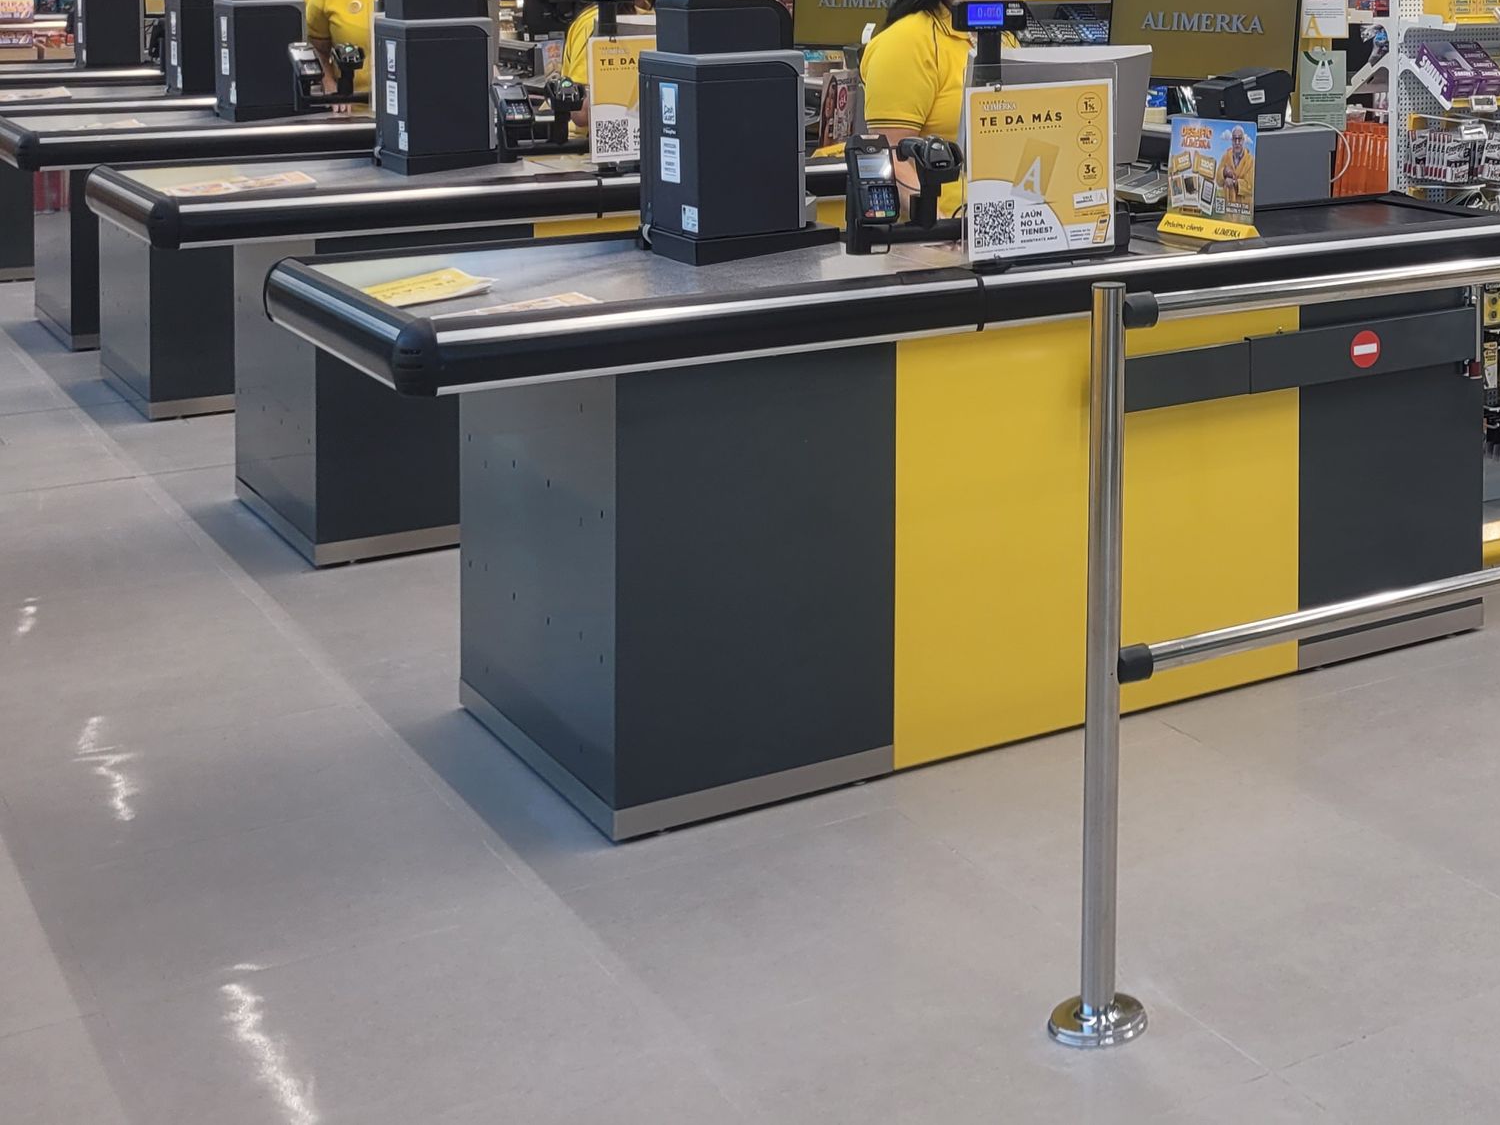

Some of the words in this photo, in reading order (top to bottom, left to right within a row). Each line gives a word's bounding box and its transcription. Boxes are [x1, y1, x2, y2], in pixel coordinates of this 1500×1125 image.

[1141, 10, 1264, 34] ALIMERKA
[600, 58, 614, 66] TE
[620, 57, 636, 65] DA
[1420, 55, 1448, 90] SMINT
[1083, 101, 1095, 111] 1%
[979, 117, 997, 127] TE
[1005, 115, 1024, 125] DA
[1032, 110, 1062, 123] MÁS
[1020, 209, 1042, 219] ¿AÚN
[1020, 220, 1032, 228] NO
[1020, 227, 1053, 236] TIENES?
